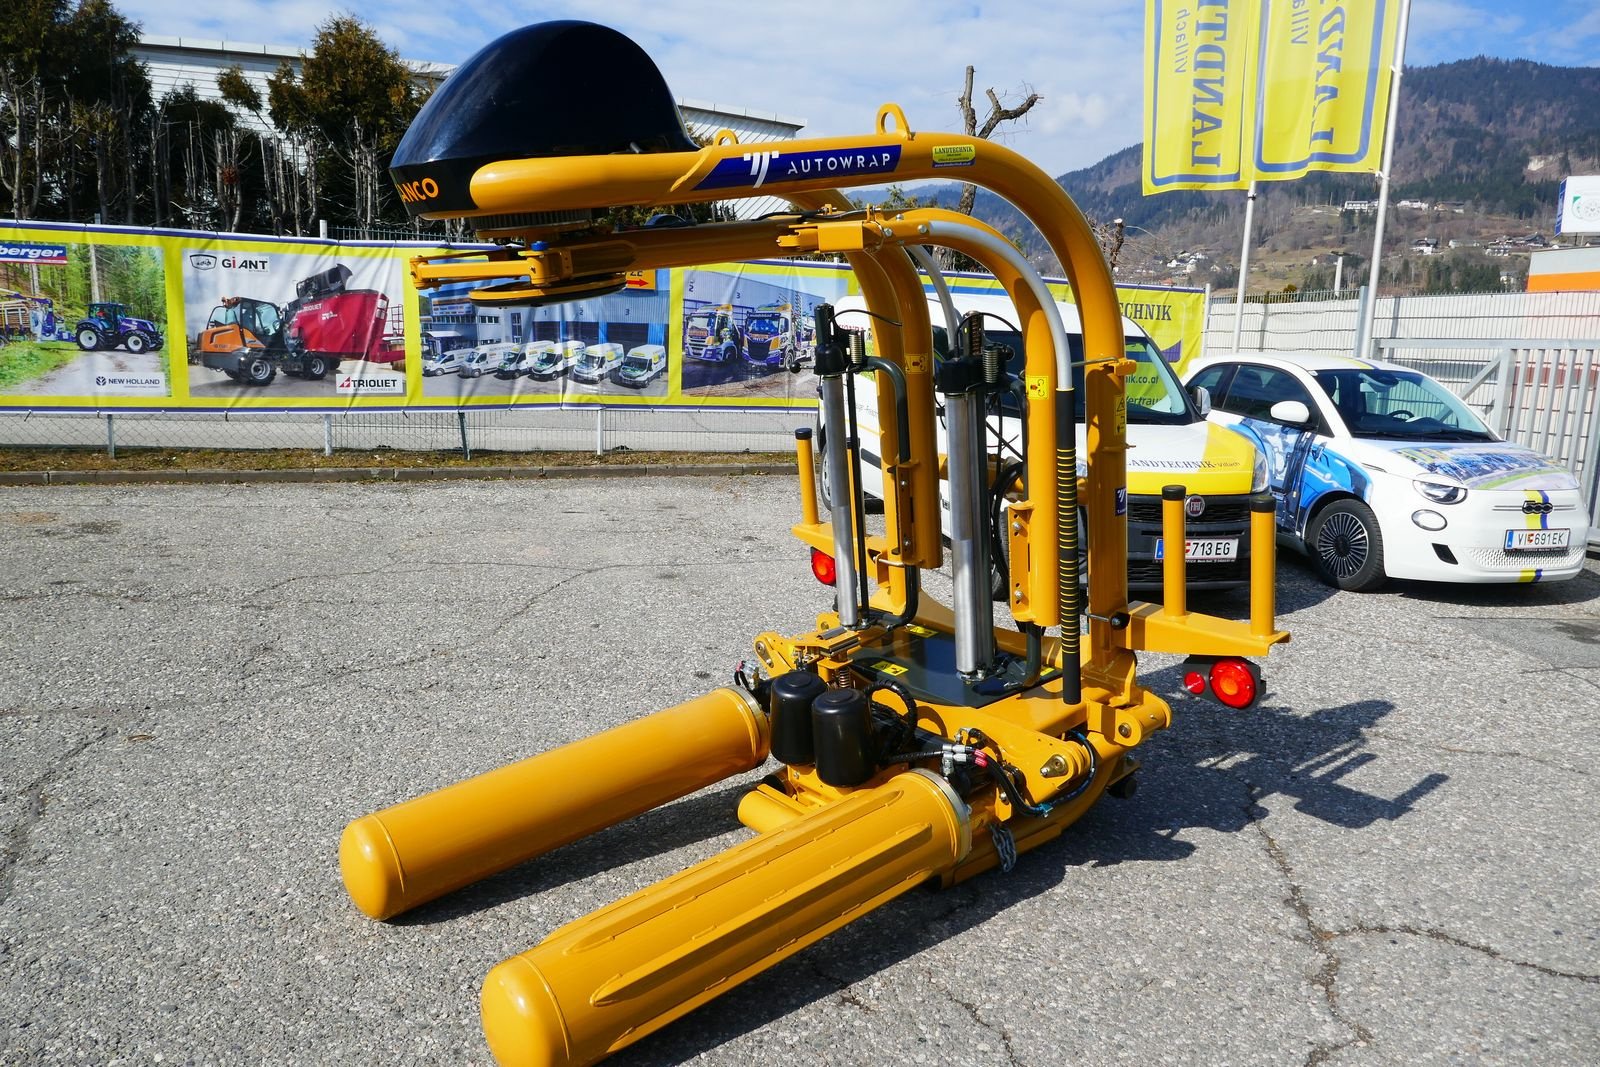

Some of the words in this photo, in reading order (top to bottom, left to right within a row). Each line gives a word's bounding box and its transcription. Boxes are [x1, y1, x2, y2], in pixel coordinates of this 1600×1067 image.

[787, 153, 891, 175] AUTOWRAP
[394, 177, 439, 203] ANCO
[625, 308, 630, 316] 3
[1522, 500, 1554, 515] 500
[1192, 542, 1213, 556] 713
[1215, 542, 1231, 556] EG
